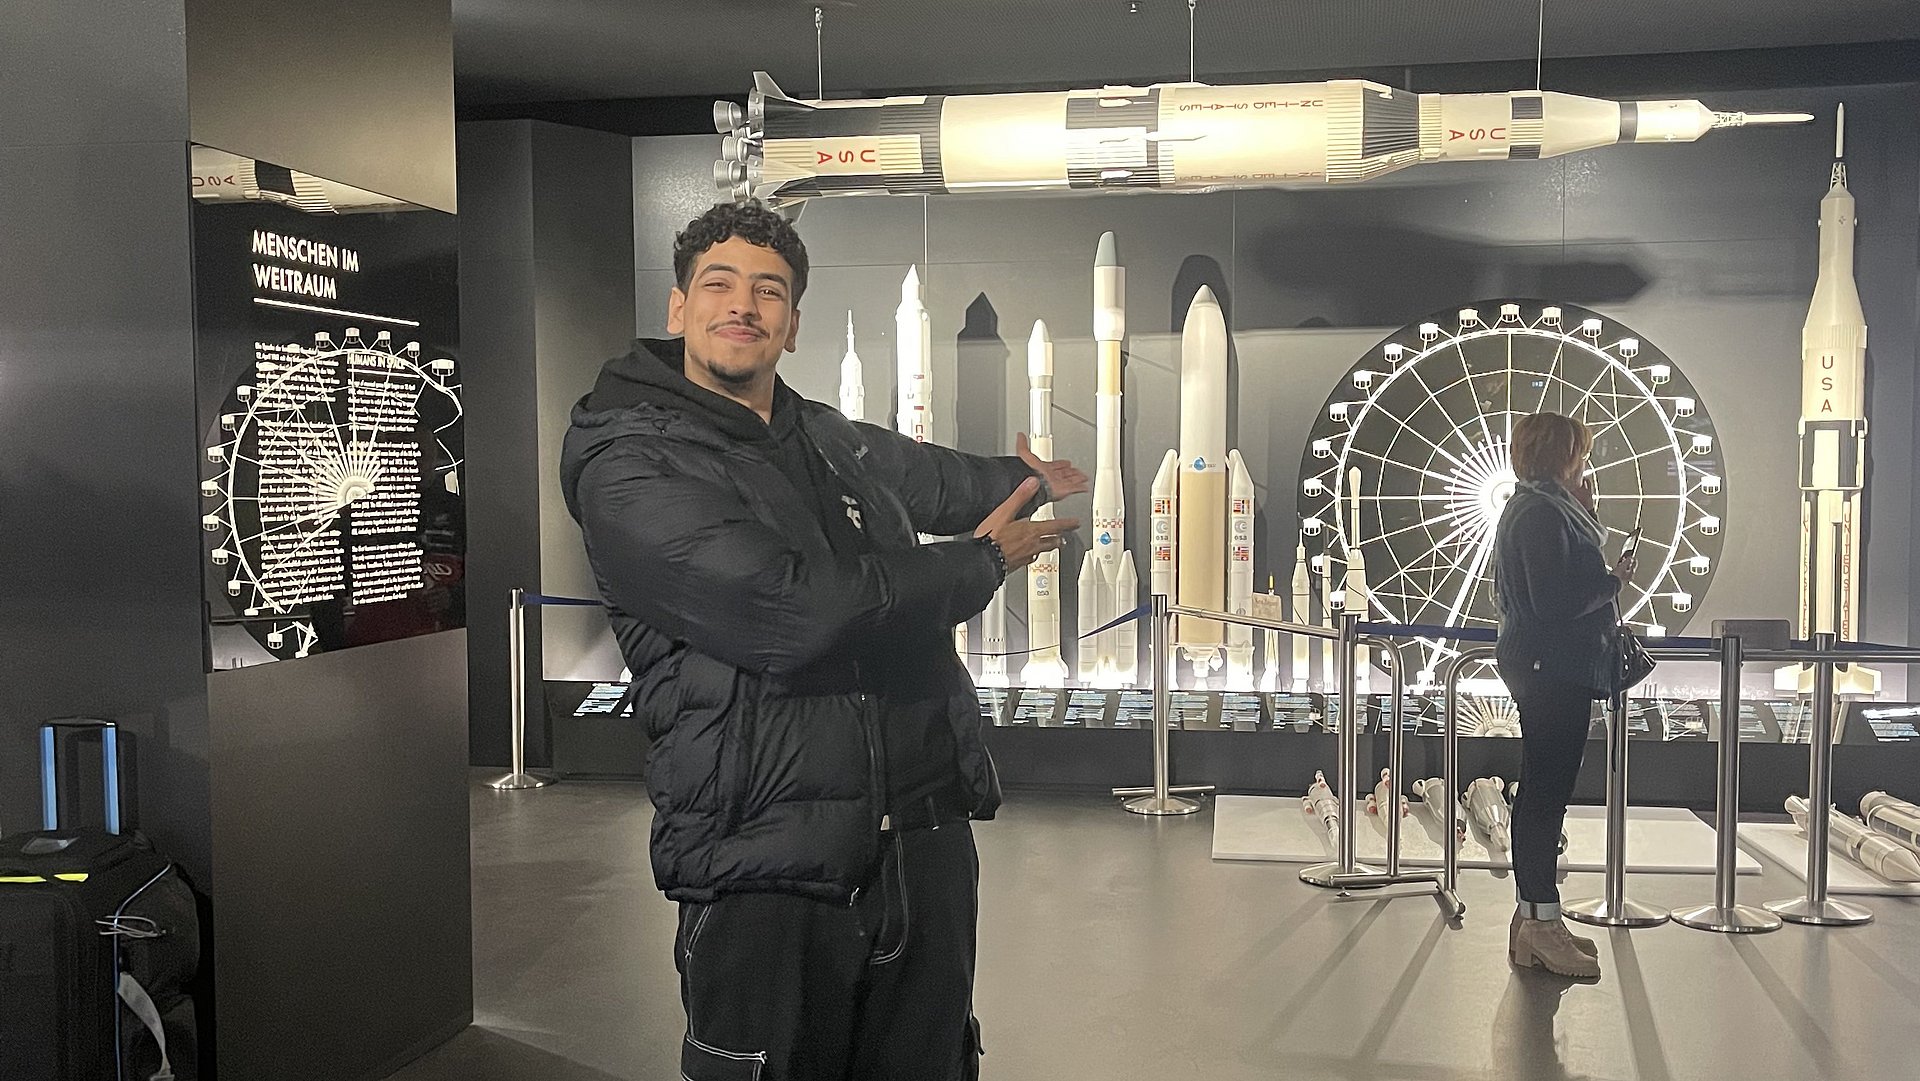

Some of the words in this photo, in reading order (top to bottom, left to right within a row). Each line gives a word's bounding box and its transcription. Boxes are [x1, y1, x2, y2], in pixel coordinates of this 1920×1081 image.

[1179, 103, 1248, 112] STATES
[1253, 100, 1324, 110] UNITED
[1448, 127, 1507, 142] USA
[816, 149, 876, 165] USA
[252, 230, 338, 269] MENSCHEN
[342, 248, 359, 272] IM
[253, 263, 337, 300] WELTRAUM
[347, 352, 377, 367] HUMANS
[377, 357, 386, 368] IN
[1821, 355, 1834, 413] USA
